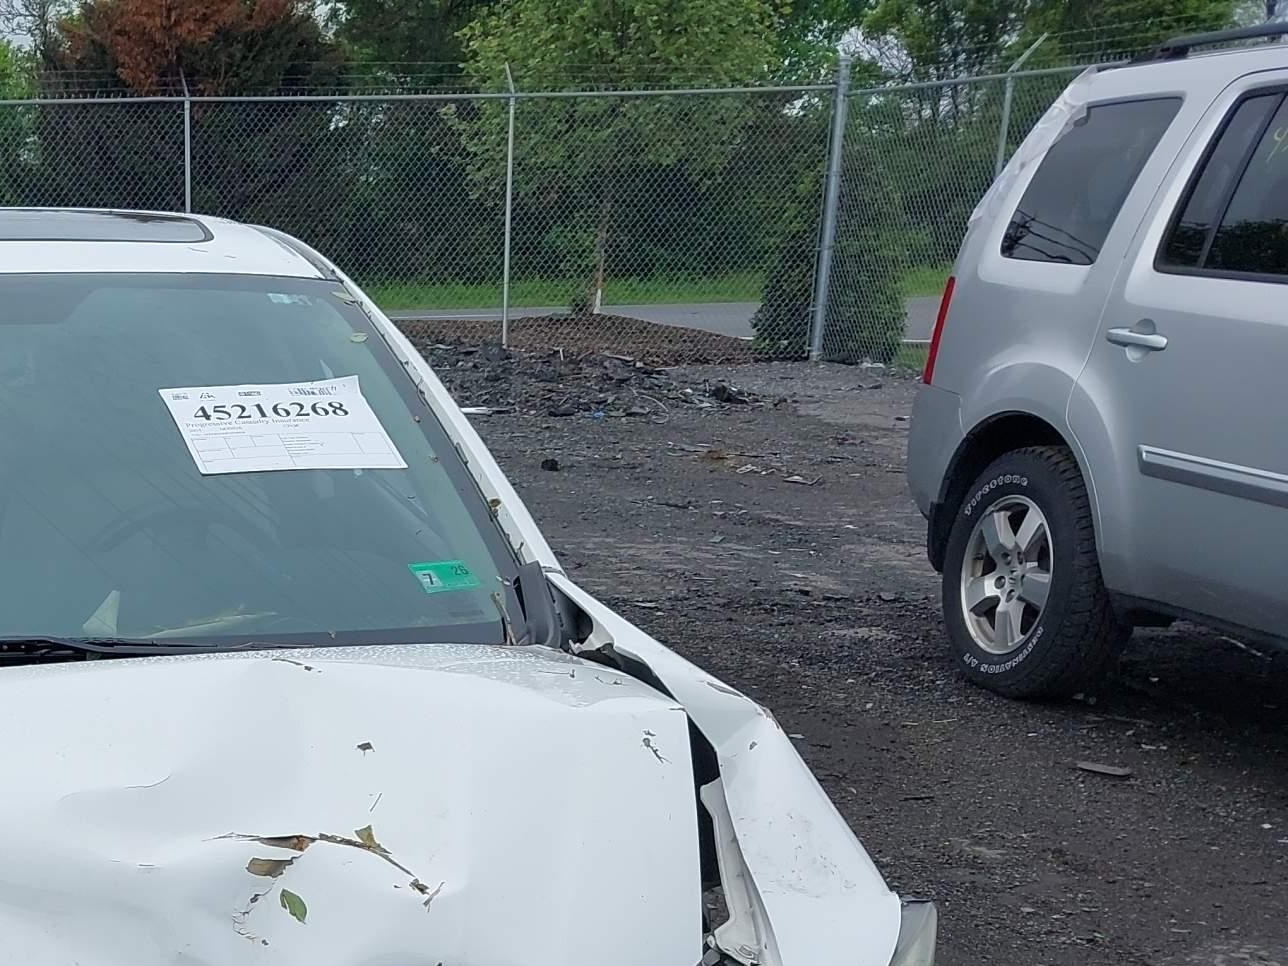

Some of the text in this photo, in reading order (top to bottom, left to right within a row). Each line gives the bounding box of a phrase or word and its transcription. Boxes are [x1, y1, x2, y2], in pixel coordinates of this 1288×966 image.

[194, 401, 349, 421] 45216268
[185, 421, 233, 429] Progressive
[422, 573, 434, 585] 7
